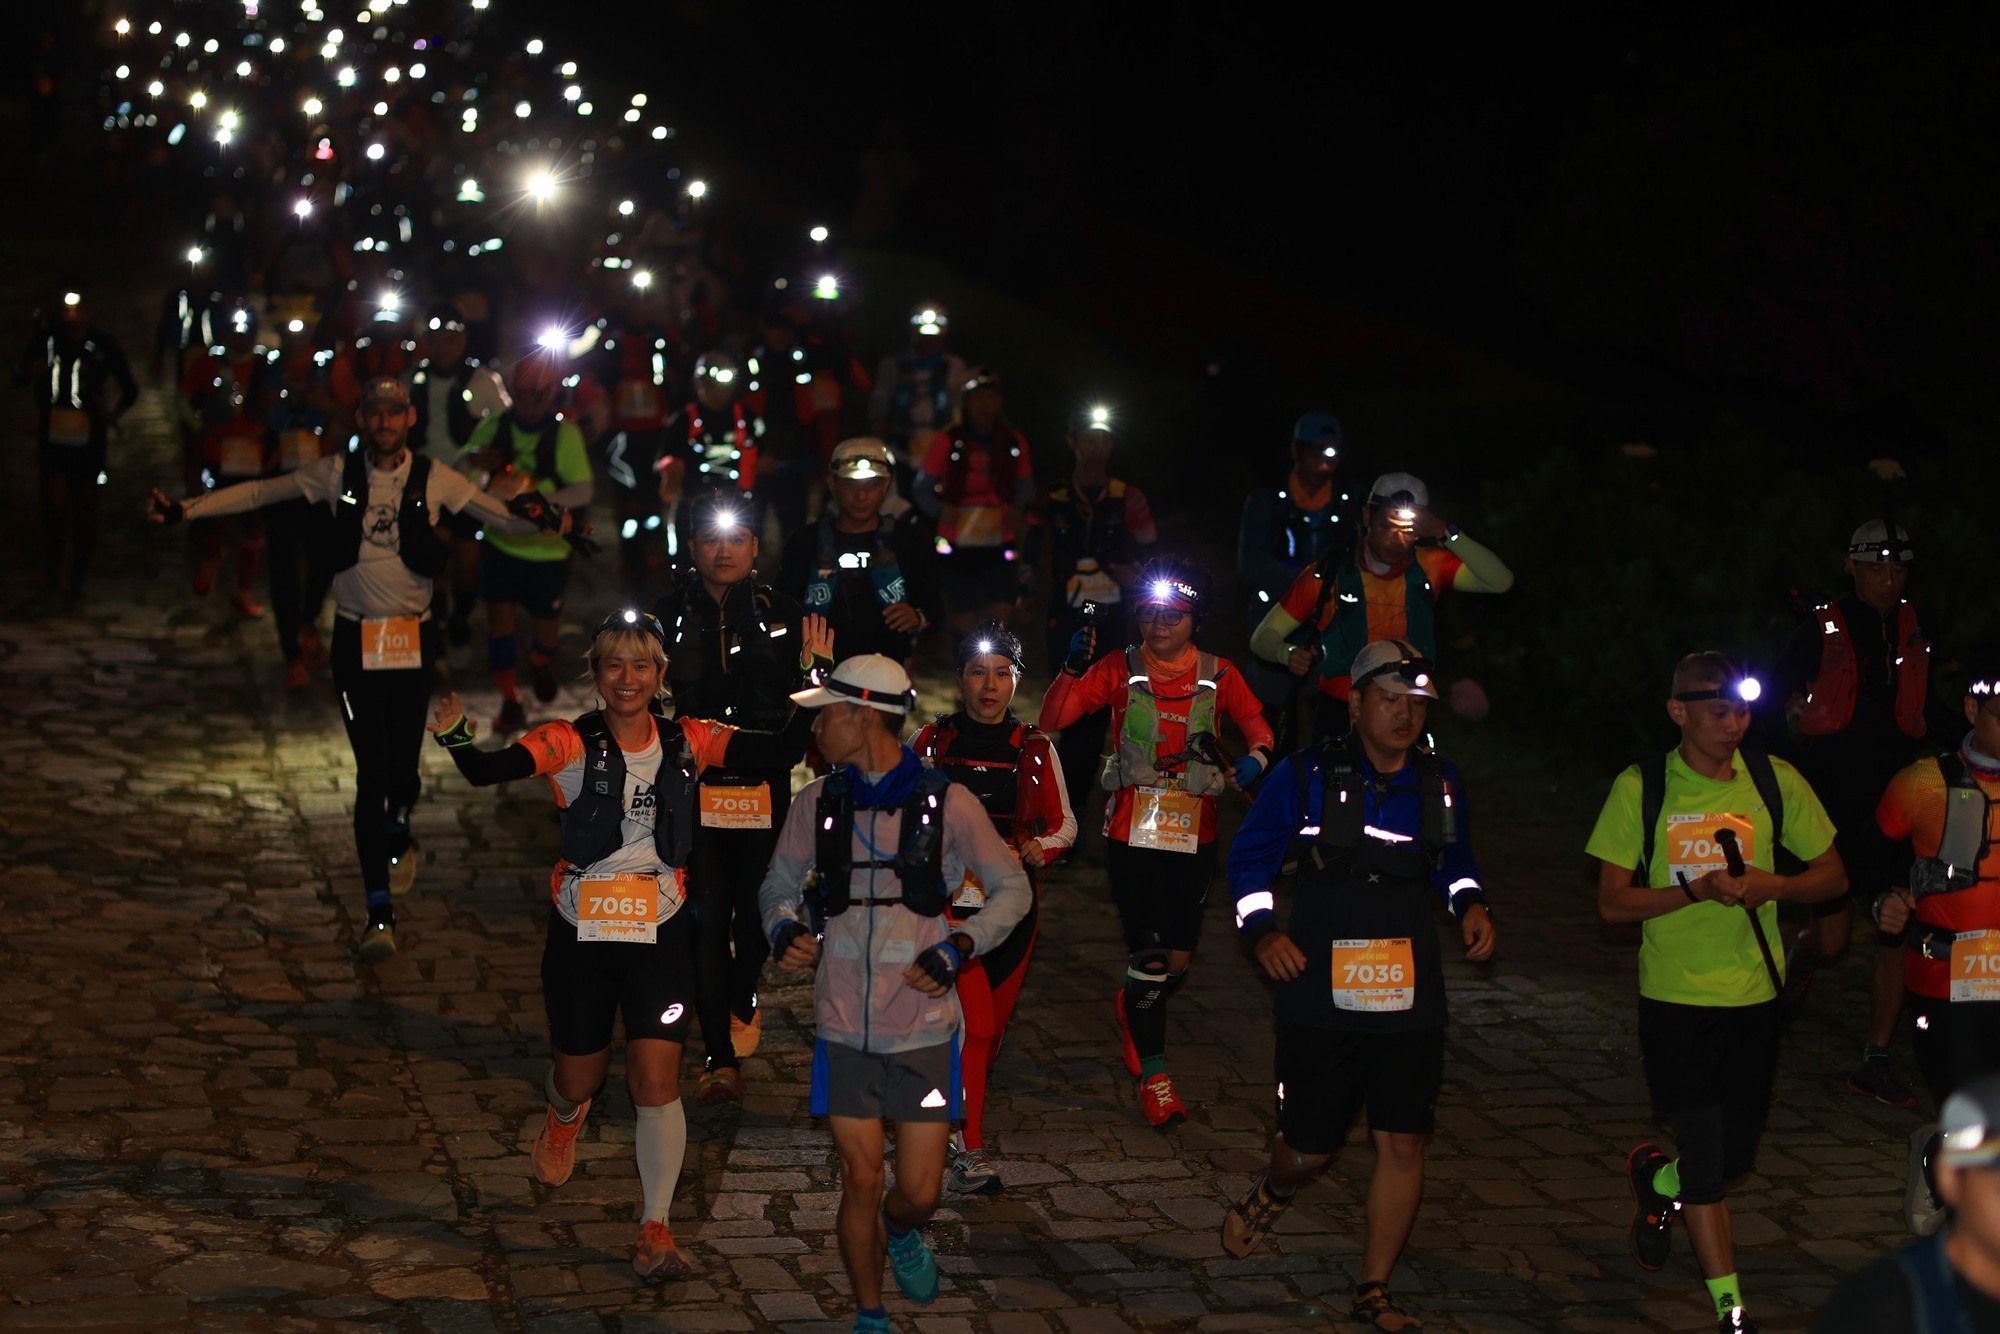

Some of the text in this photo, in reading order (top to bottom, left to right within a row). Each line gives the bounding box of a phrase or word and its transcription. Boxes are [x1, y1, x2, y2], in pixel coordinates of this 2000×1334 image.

[711, 797, 760, 812] 7061
[589, 896, 648, 917] 7065
[1343, 963, 1404, 984] 7036
